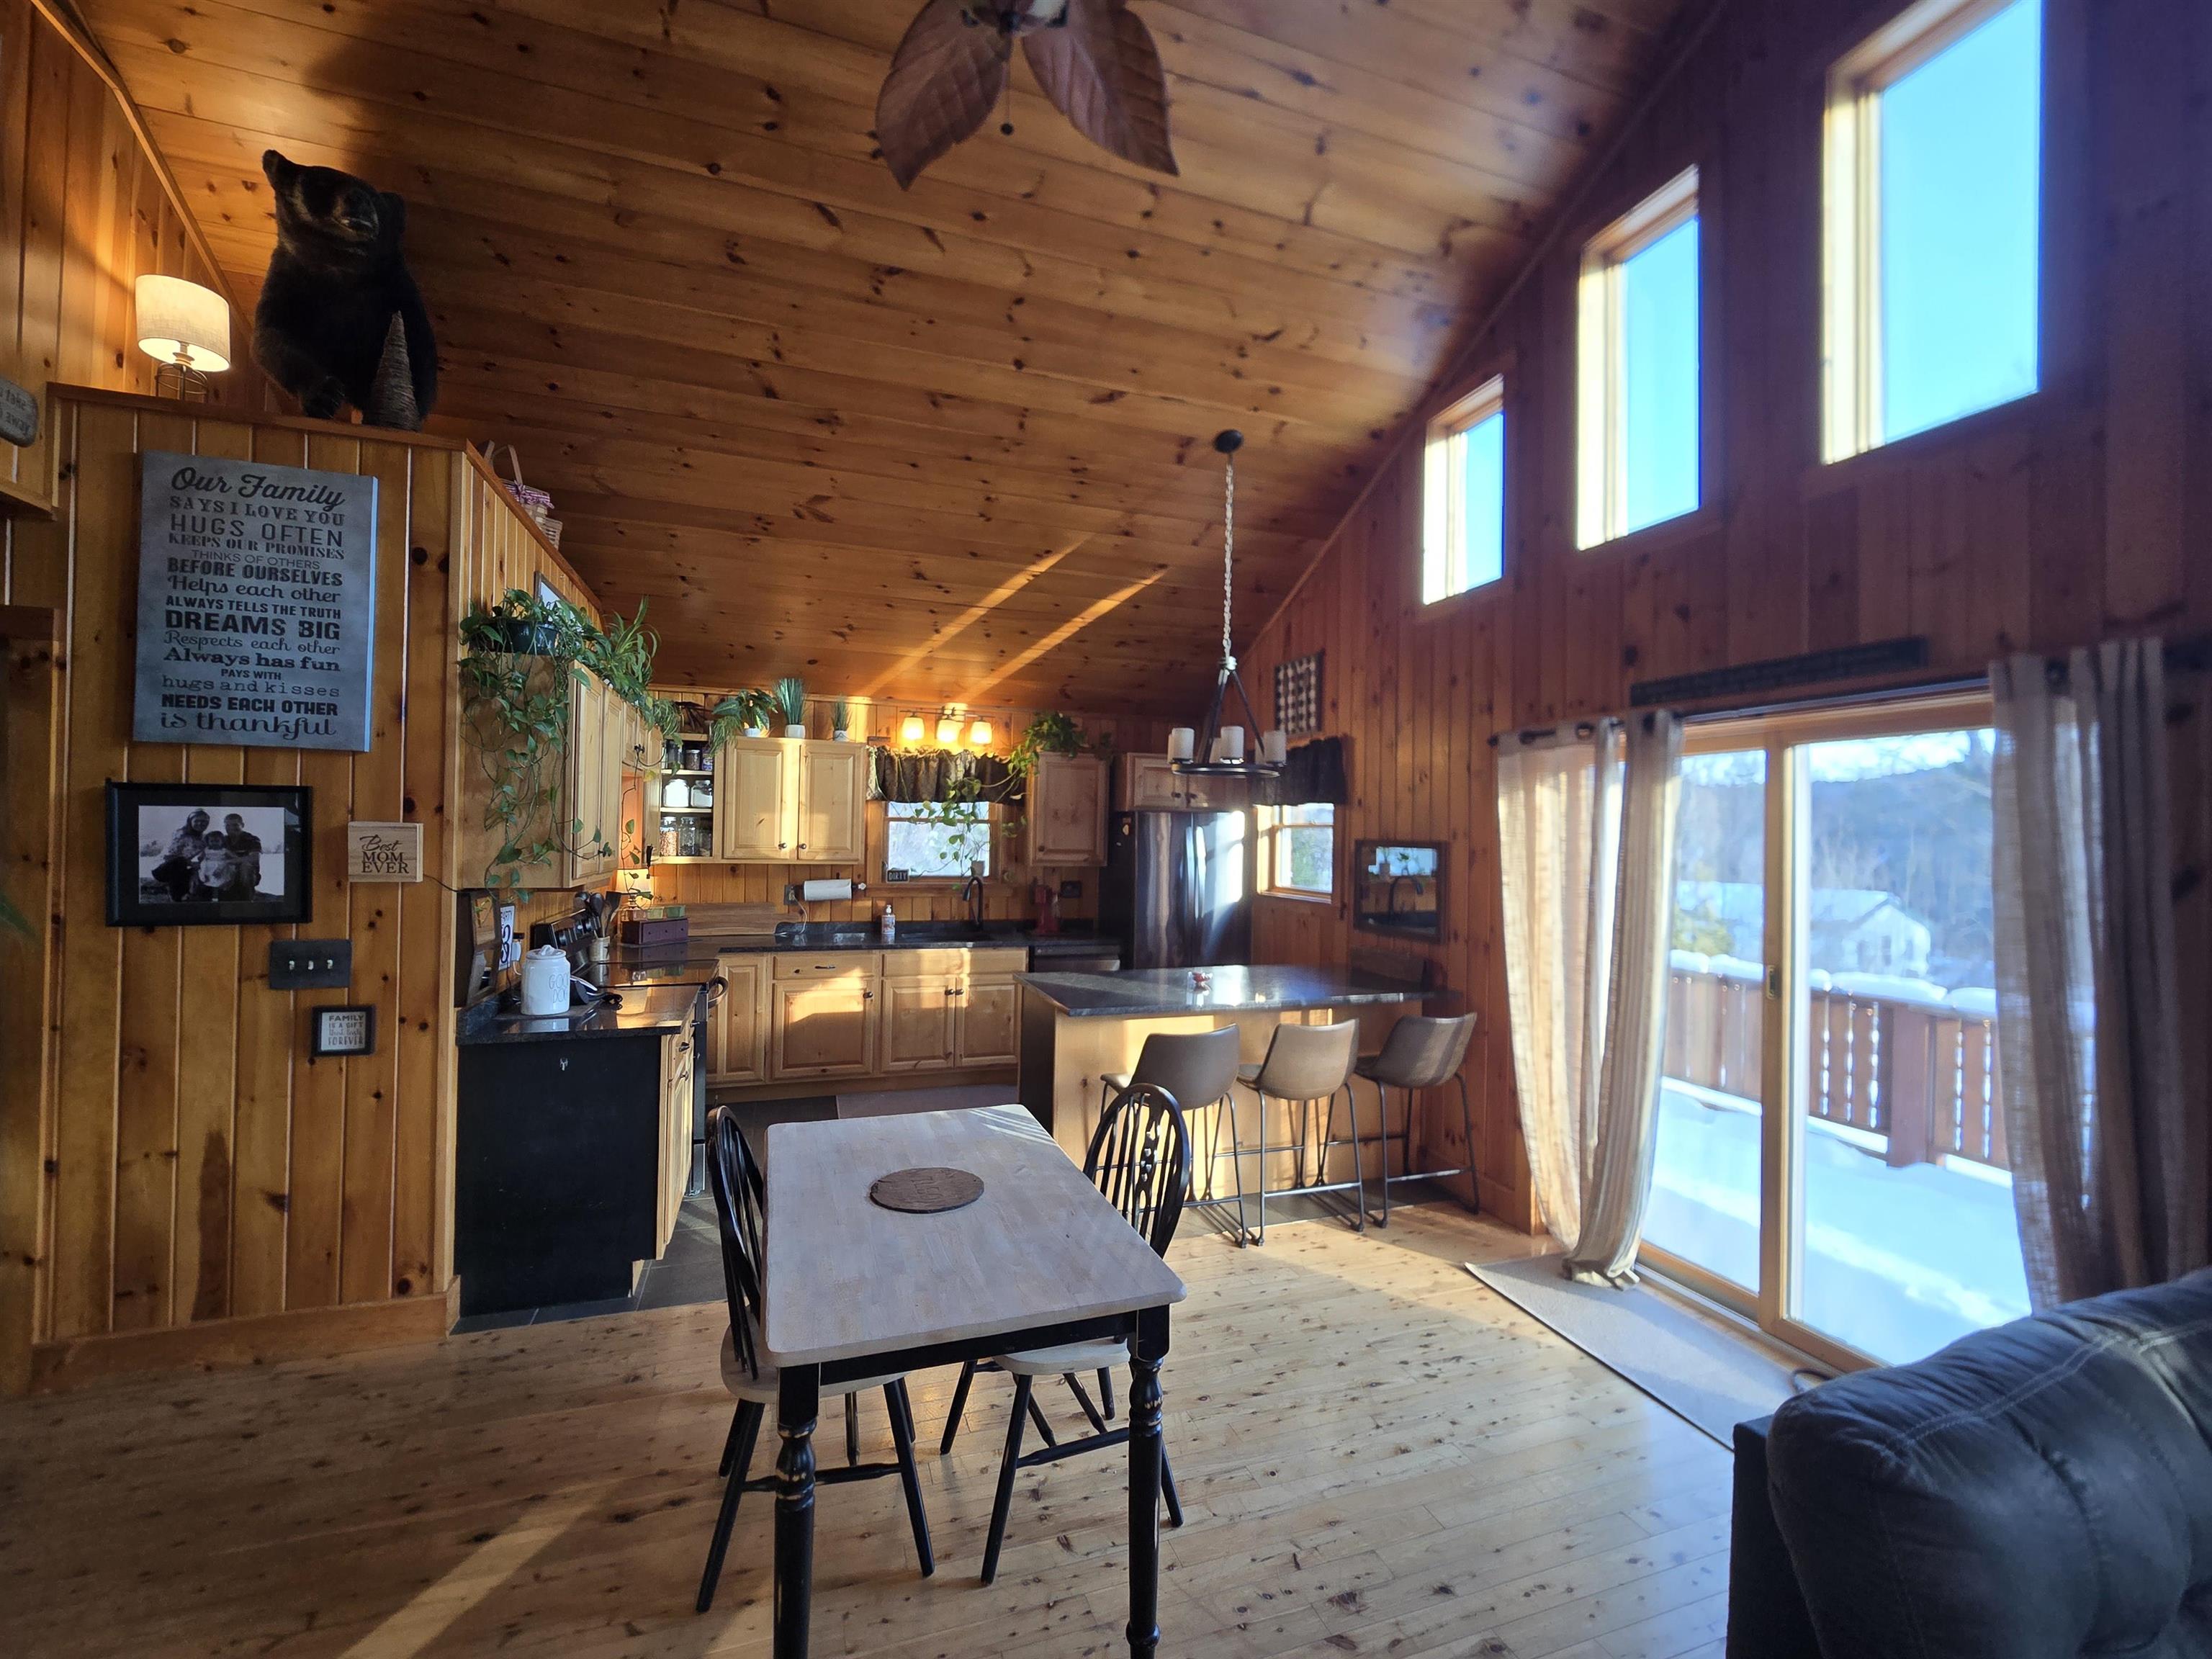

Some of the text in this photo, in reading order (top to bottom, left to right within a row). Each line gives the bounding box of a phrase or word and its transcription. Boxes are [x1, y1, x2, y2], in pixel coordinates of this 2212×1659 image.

[6, 412, 30, 435] away
[171, 467, 346, 512] Our Family
[170, 495, 345, 526] SAYS I LOVE YOU
[171, 513, 343, 547] HUGS OFTEN
[168, 533, 344, 560] KEEPS OUR PROMISES
[167, 557, 343, 586] BEFORE OURSELVES
[192, 549, 320, 570] THINKS OF OTHERS
[167, 575, 341, 603] Helps each other
[166, 595, 341, 619] ALWAYS TELLS THE TRUTH
[165, 609, 341, 640] DREAMS BIG
[164, 630, 341, 655] Respects each other
[163, 647, 341, 672] Always has fun
[162, 674, 340, 698] hugs and kisses
[220, 668, 282, 680] PAYS WITH
[162, 693, 338, 716] NEEDS EACH OTHER
[161, 711, 337, 741] is thankful
[359, 834, 403, 852] Best
[361, 850, 405, 863] MOM
[361, 861, 410, 874] EVER
[549, 974, 569, 989] GOO
[552, 988, 567, 1003] DO
[328, 1036, 364, 1046] FOREVER
